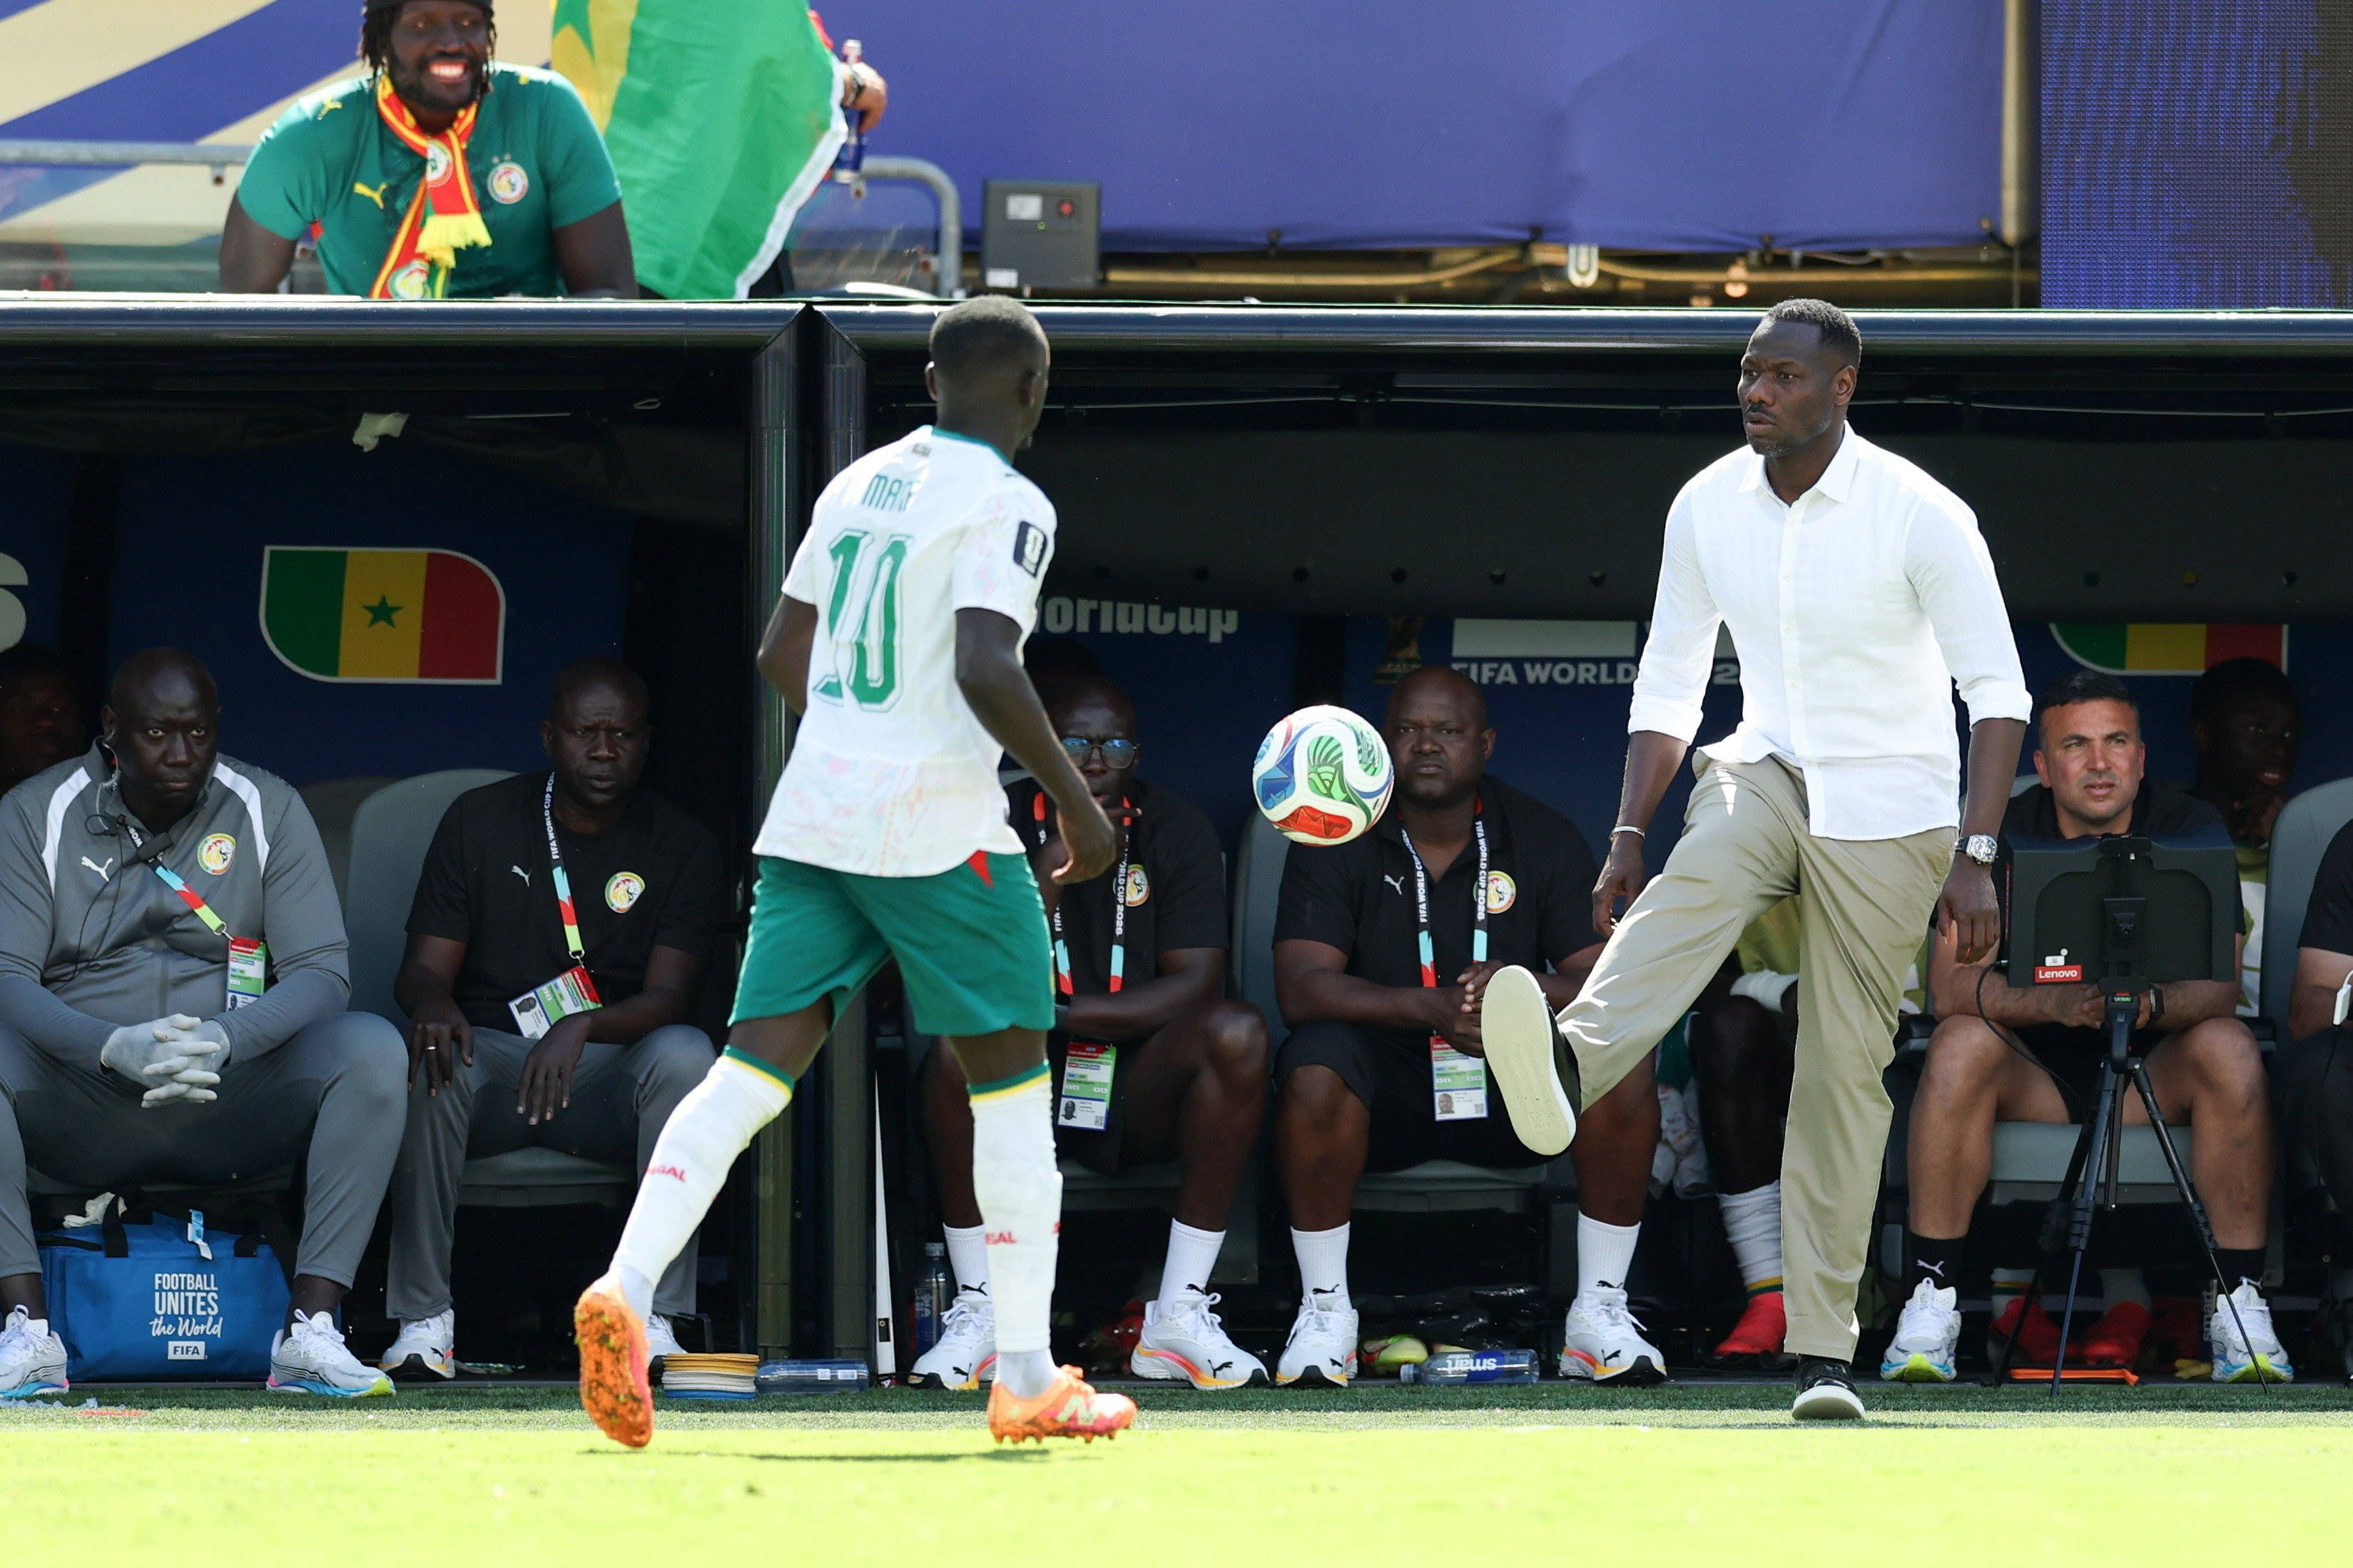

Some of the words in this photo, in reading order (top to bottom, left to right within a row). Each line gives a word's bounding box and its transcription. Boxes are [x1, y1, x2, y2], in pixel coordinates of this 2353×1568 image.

[813, 528, 915, 713] 10
[1523, 663, 1639, 685] WORLD
[545, 809, 554, 841] WORLD
[1475, 820, 1484, 838] FIFA
[550, 840, 559, 860] FIFA
[1478, 838, 1487, 870] WORLD
[1413, 854, 1423, 870] CUP
[1417, 870, 1425, 904] WORLD
[2038, 969, 2078, 979] Lenovo
[154, 1273, 218, 1290] FOOTBALL
[155, 1292, 219, 1315] UNITES
[149, 1315, 176, 1336] the
[178, 1315, 223, 1338] World
[173, 1346, 200, 1355] FIFA
[1445, 1358, 1498, 1374] smart
